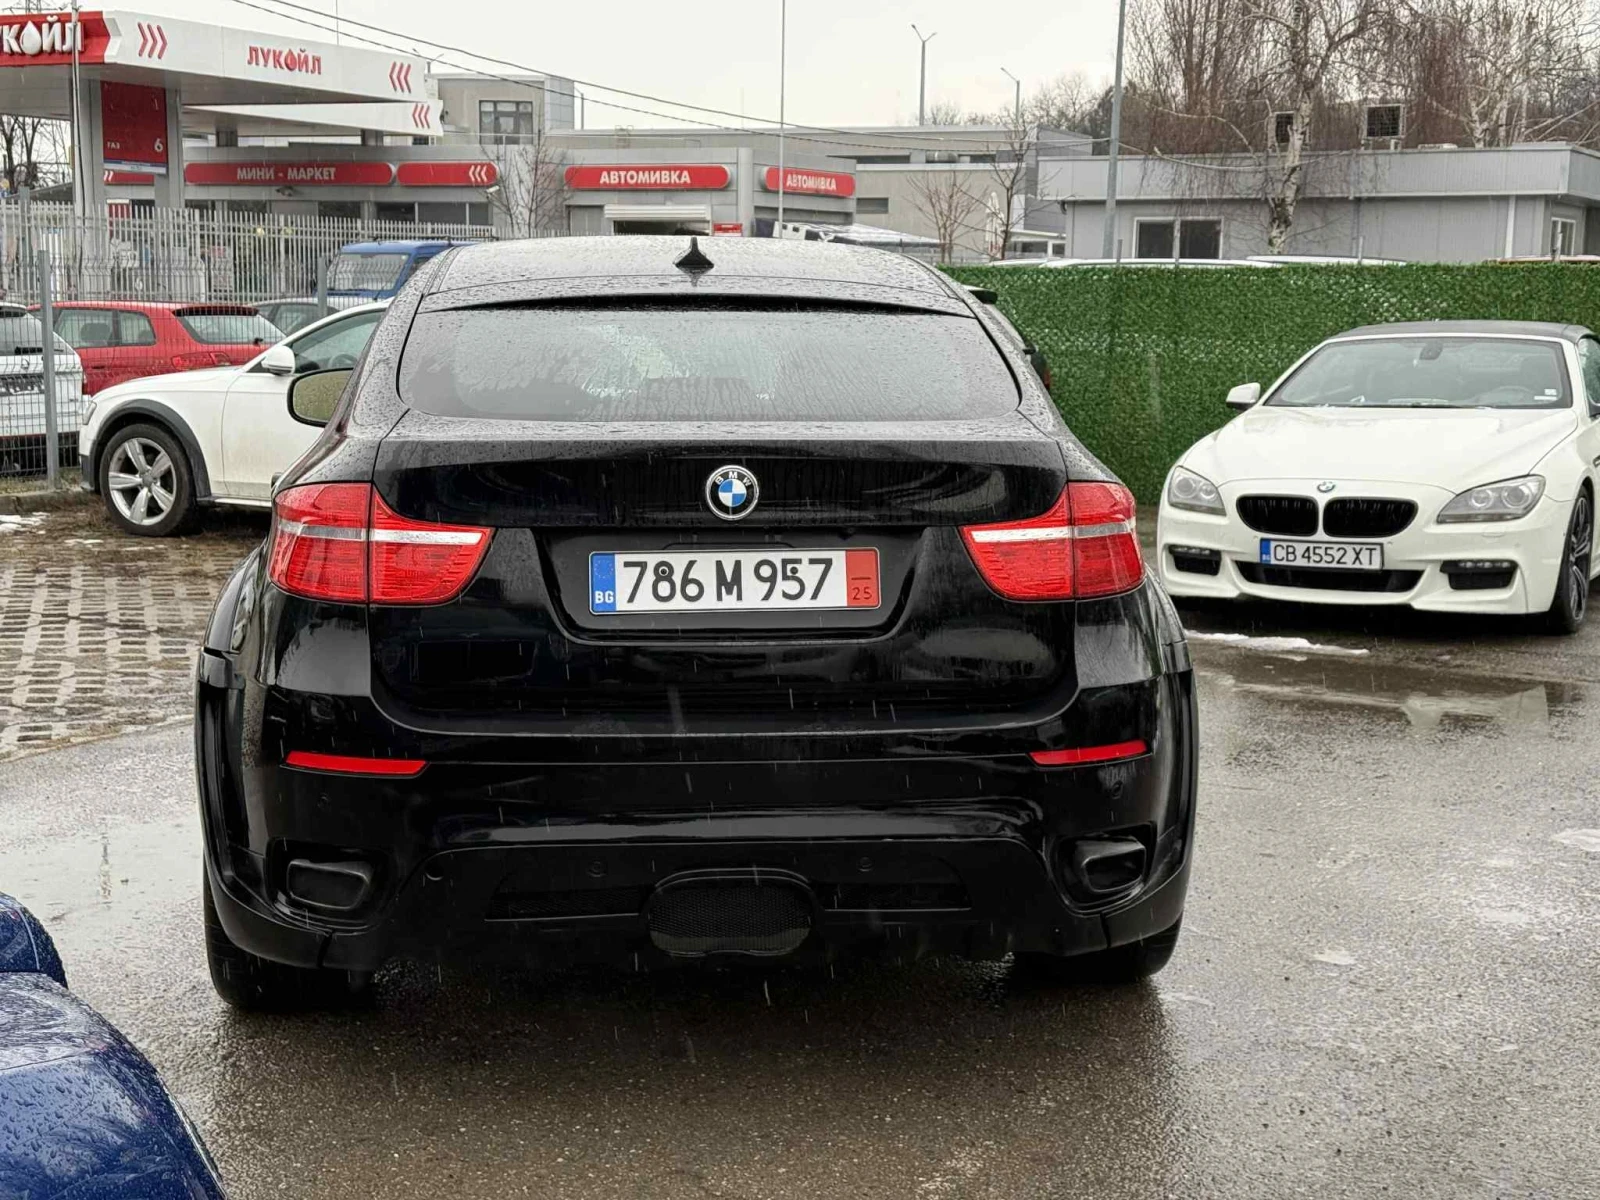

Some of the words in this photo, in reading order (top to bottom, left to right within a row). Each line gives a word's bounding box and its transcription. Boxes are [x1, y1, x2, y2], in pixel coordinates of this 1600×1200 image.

[0, 15, 81, 55] КОЙЛ
[247, 45, 321, 75] ЛУКОЙЛ
[237, 167, 274, 180] МИНИ
[287, 167, 336, 180] МАРКЕТ
[600, 170, 691, 184] АВТОМИВКА
[786, 174, 837, 190] АВТОМИВКА
[715, 471, 752, 486] BMW
[1273, 544, 1297, 562] CB
[1301, 546, 1347, 564] 4552
[1352, 547, 1377, 565] XT
[623, 560, 704, 603] 786
[716, 560, 742, 601] M
[754, 558, 833, 600] 957
[595, 591, 614, 603] BG
[852, 586, 872, 600] 25
